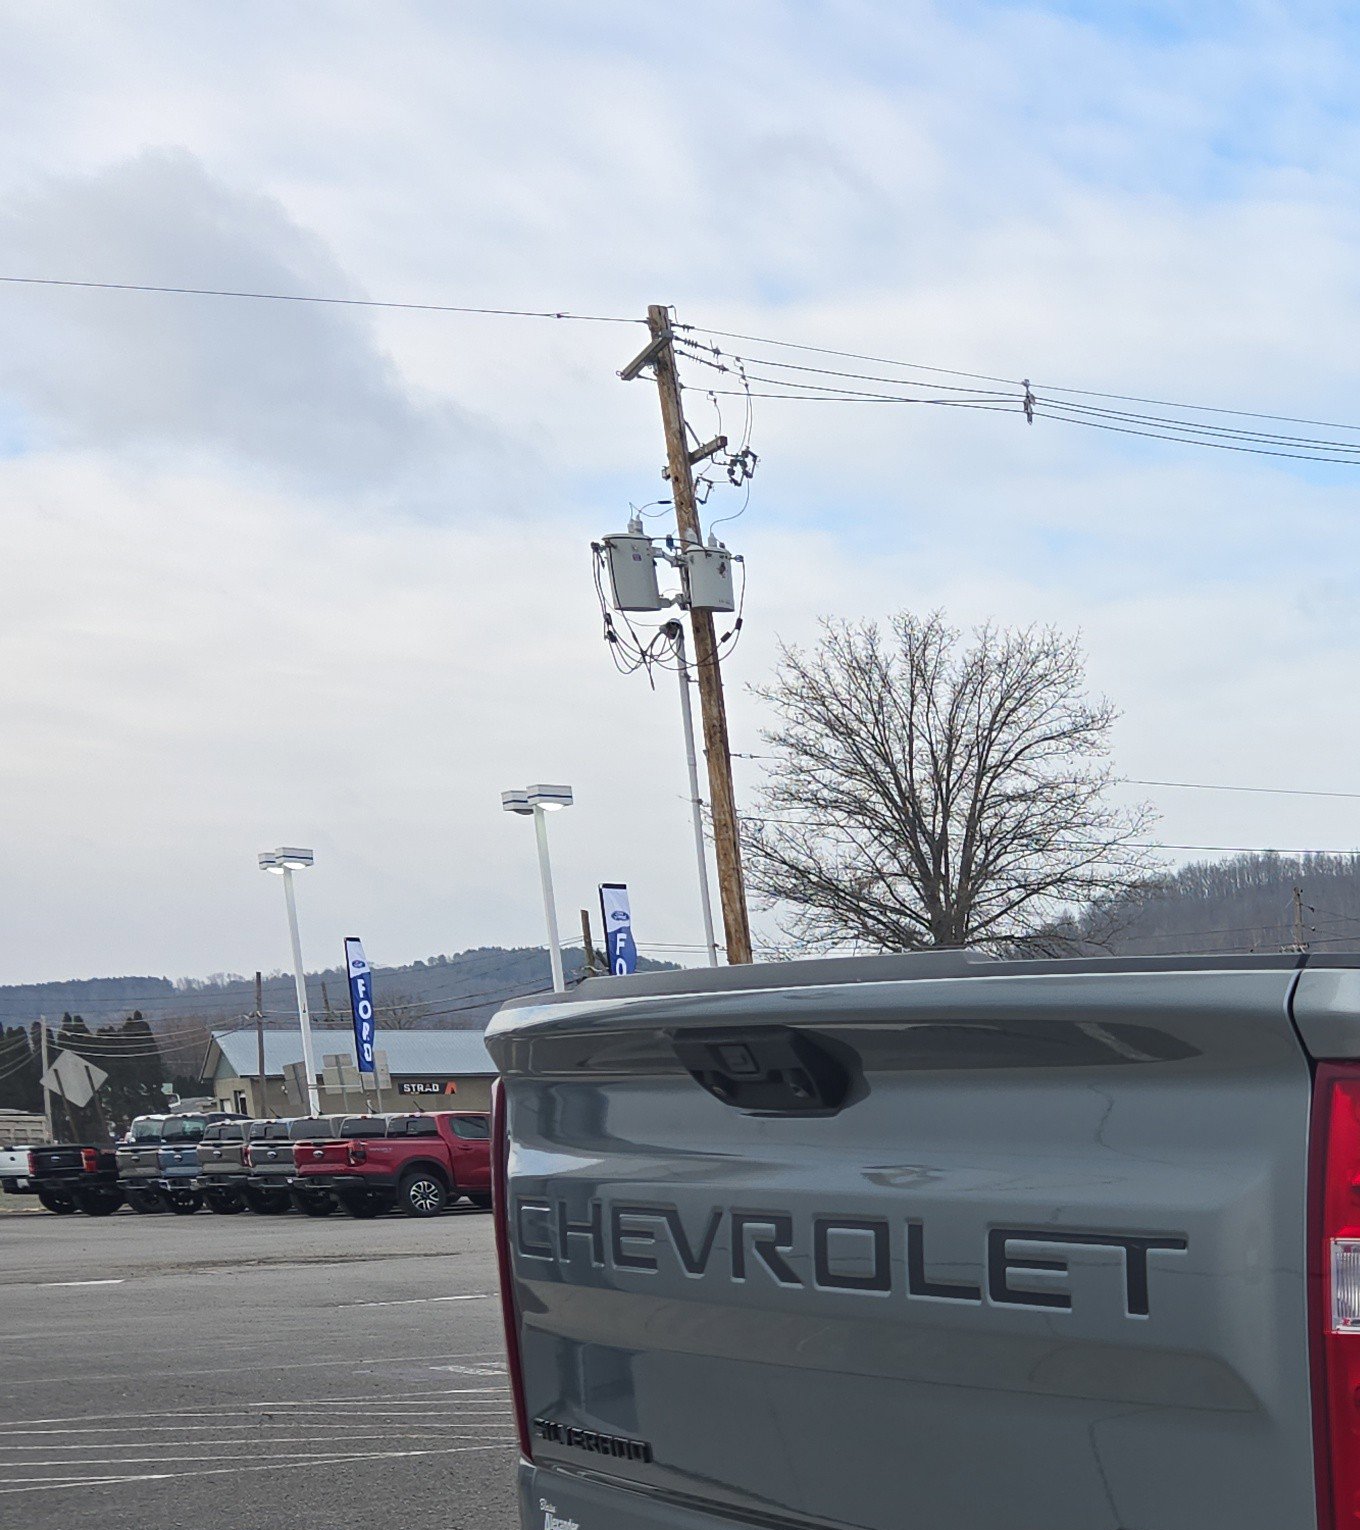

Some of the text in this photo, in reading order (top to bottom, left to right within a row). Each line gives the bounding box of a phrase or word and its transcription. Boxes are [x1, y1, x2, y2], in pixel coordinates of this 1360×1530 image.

[615, 932, 627, 976] FO
[356, 978, 372, 1062] FORD
[515, 1200, 1189, 1320] CHEVROLET
